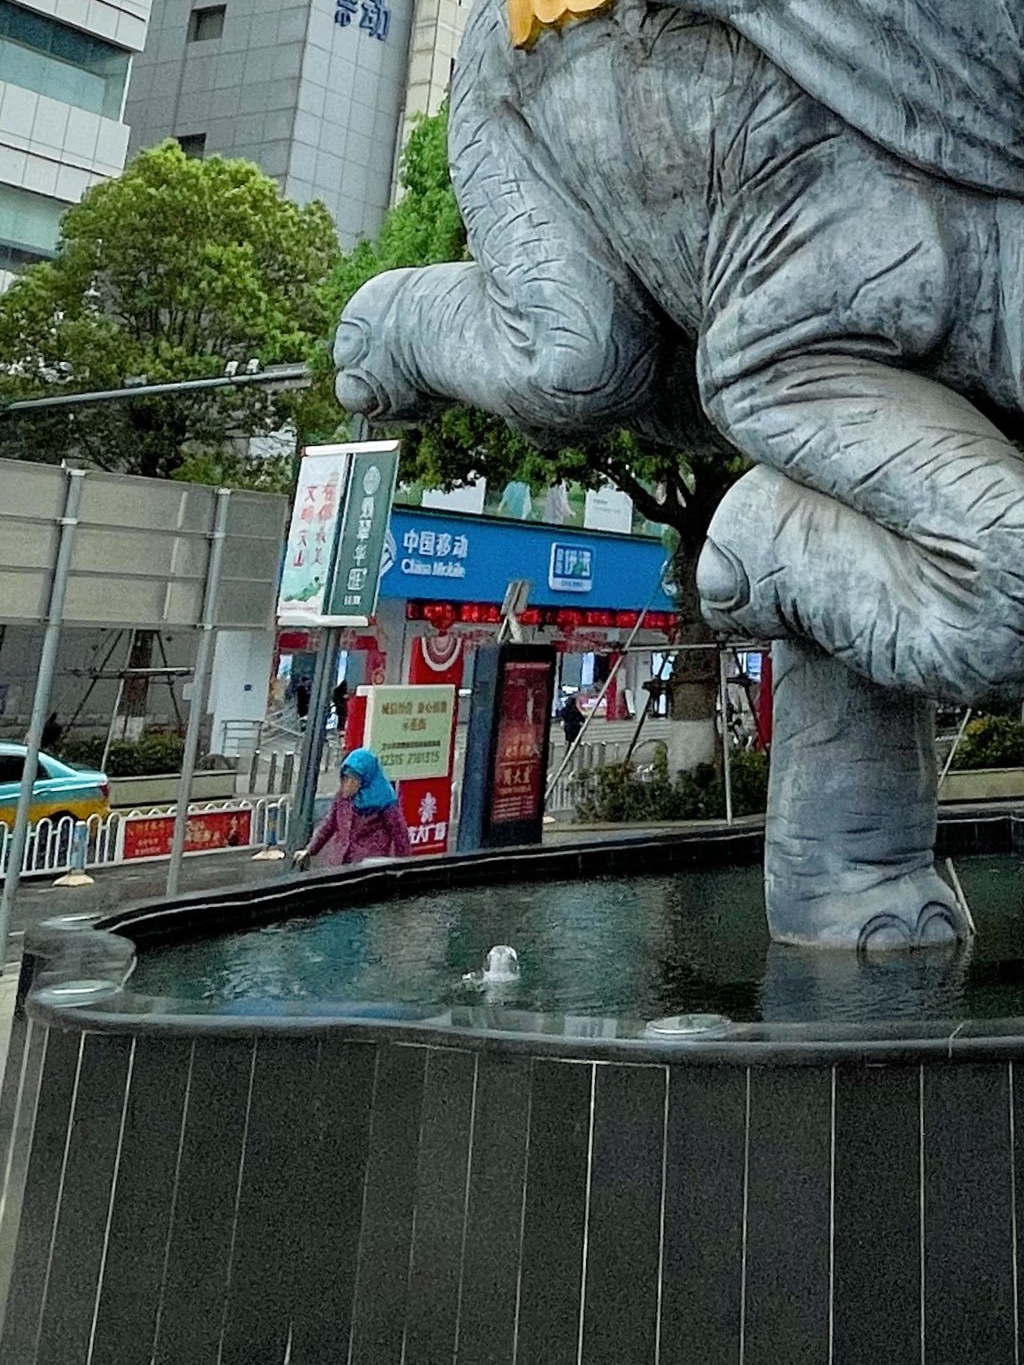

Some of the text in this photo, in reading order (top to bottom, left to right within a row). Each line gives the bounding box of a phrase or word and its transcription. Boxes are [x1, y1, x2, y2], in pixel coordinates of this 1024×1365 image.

[403, 528, 469, 559] 中国移动
[401, 558, 467, 578] China Mobile
